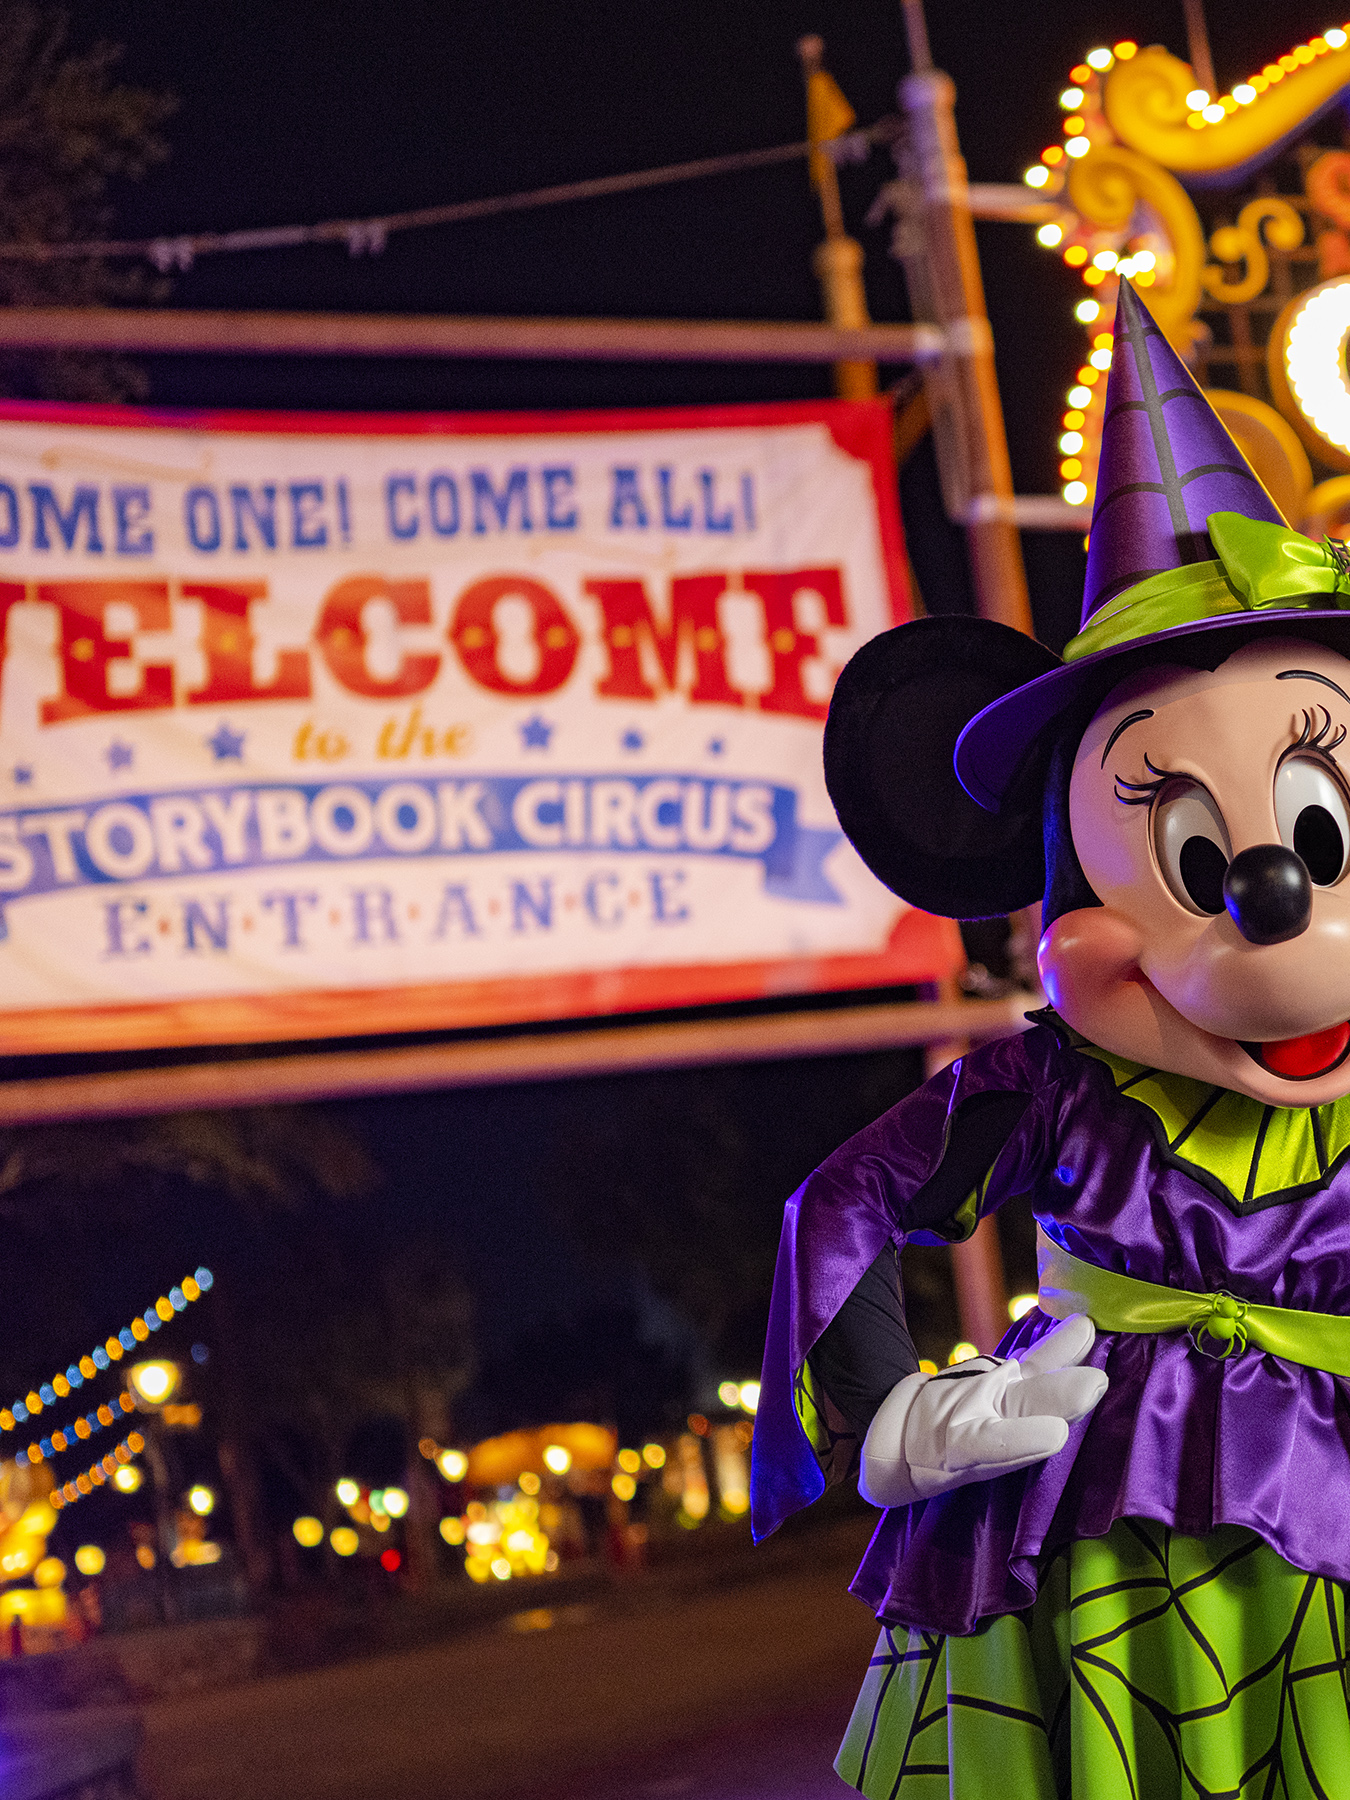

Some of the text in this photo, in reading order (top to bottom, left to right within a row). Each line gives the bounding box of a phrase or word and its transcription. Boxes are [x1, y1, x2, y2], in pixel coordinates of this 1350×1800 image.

[183, 478, 352, 555] ONE!
[385, 464, 580, 541] COME
[608, 463, 758, 536] ALL!
[0, 568, 851, 726] ELCOME
[291, 701, 475, 764] to the
[512, 779, 777, 855] CIRCUS
